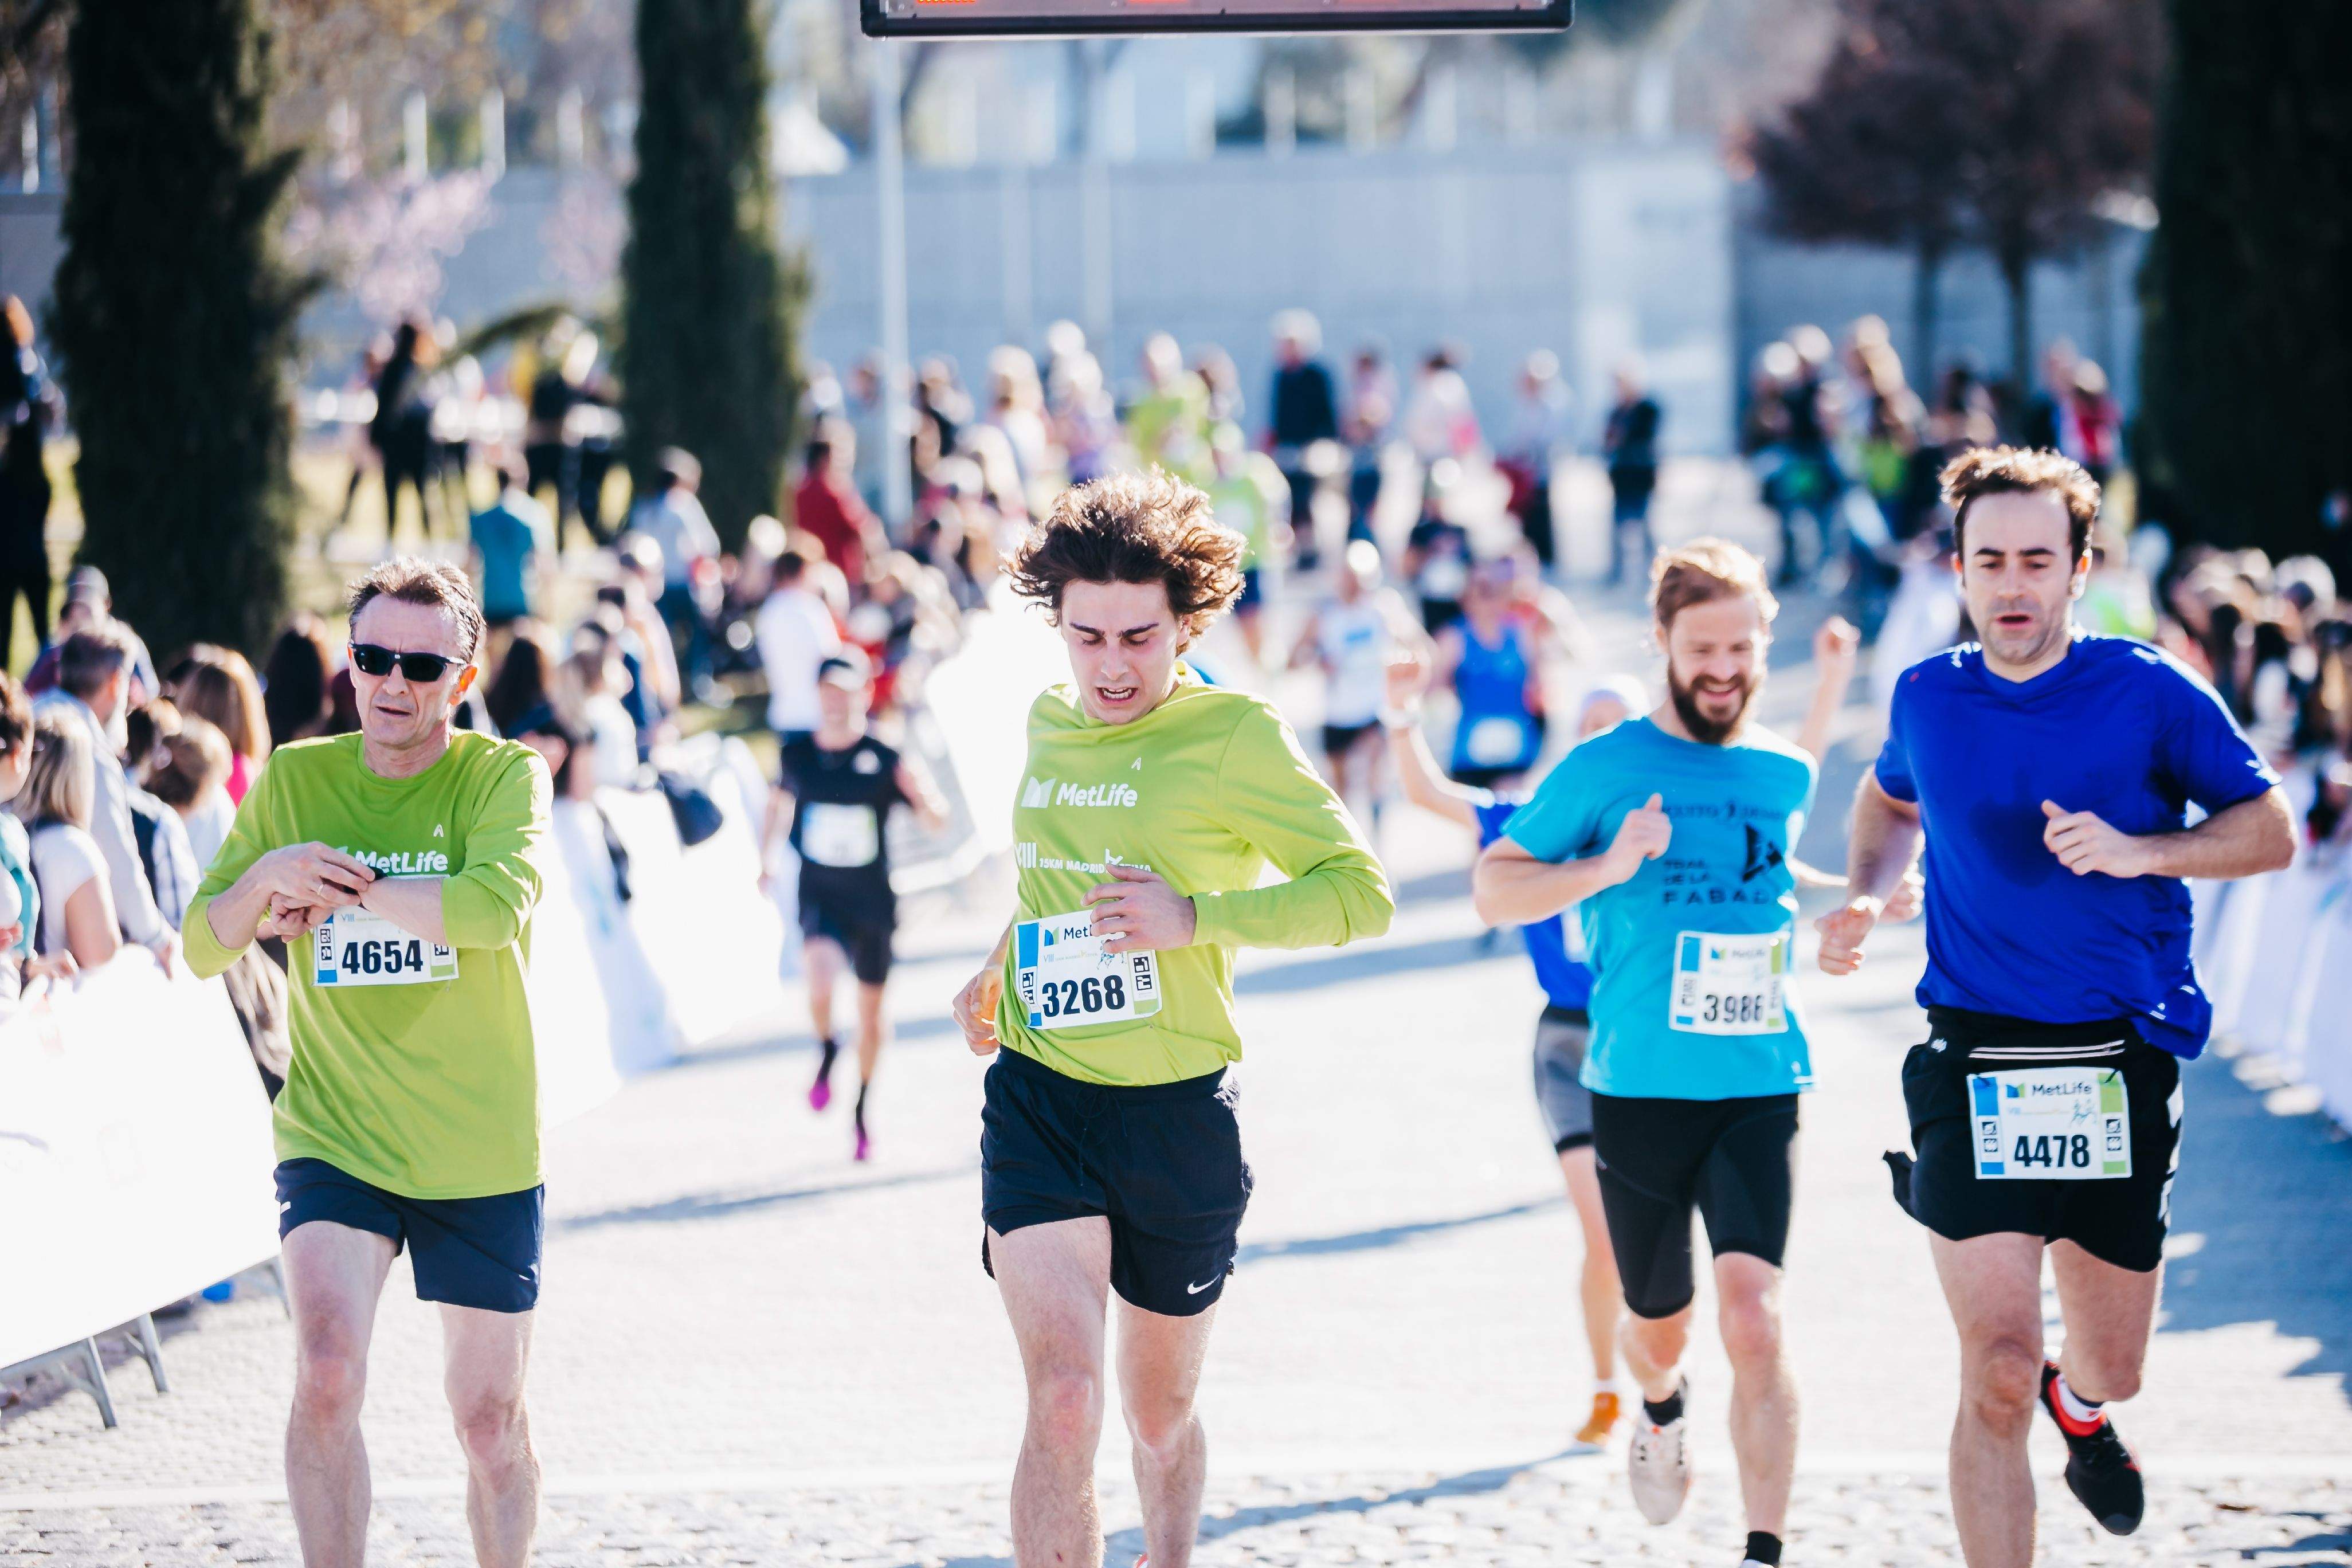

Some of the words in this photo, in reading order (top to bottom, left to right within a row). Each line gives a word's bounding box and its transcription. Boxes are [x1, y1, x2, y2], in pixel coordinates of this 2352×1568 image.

[1056, 783, 1138, 807] MetLife
[355, 850, 448, 873] MetLife
[1040, 858, 1063, 869] 15KM
[1067, 861, 1105, 874] MADRID
[342, 940, 424, 974] 4654
[1042, 975, 1125, 1017] 3268
[2032, 1082, 2092, 1096] MetLife
[2014, 1134, 2090, 1167] 4478
